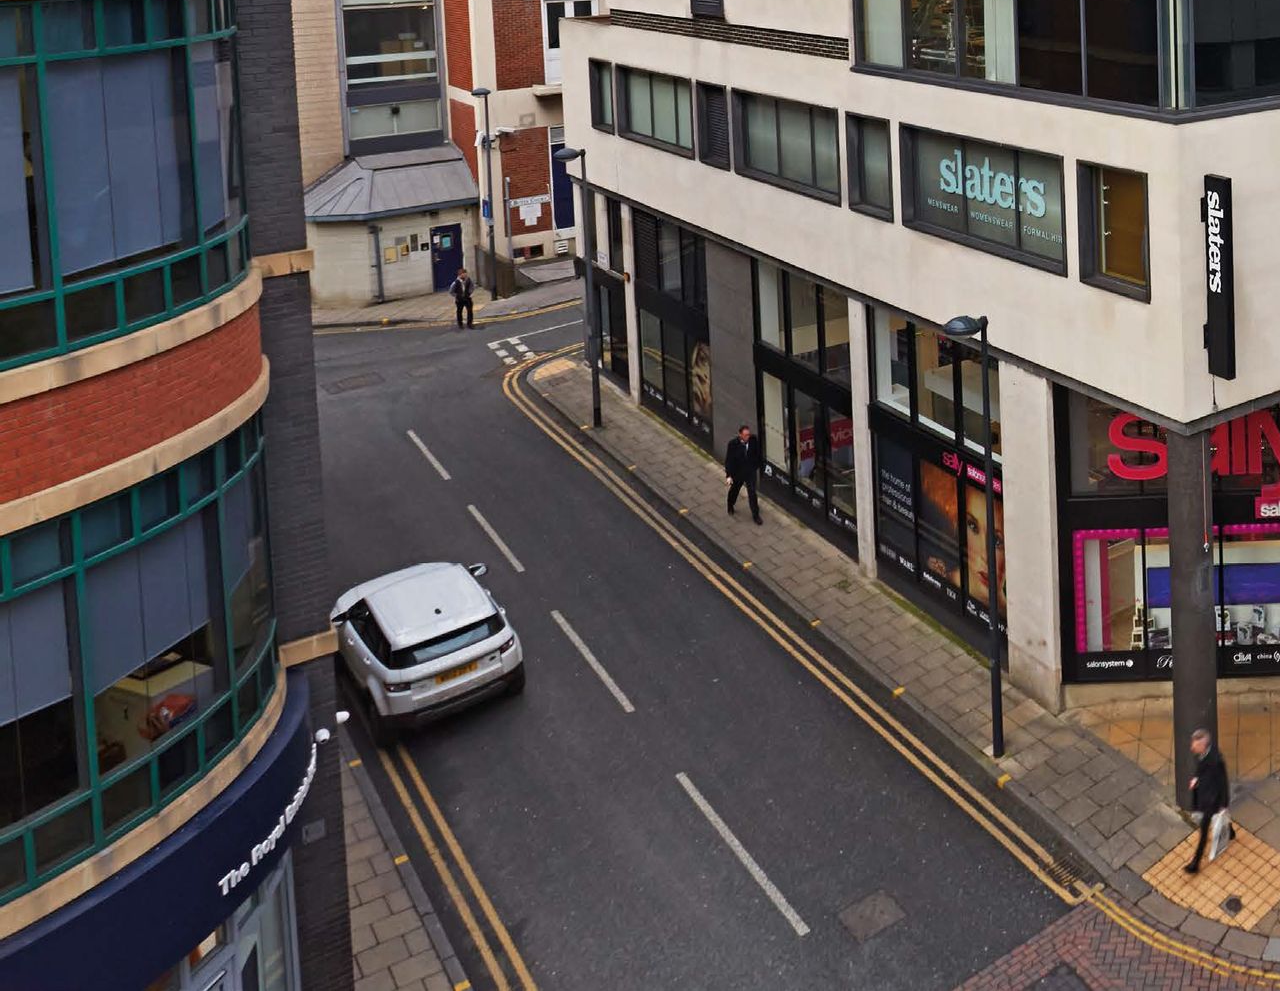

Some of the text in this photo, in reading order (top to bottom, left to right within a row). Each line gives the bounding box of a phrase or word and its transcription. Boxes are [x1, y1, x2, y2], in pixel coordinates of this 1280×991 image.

[940, 149, 1046, 218] slaters
[928, 197, 959, 213] MENSWEAR
[970, 210, 1014, 229] WOMENSWEAR
[1023, 225, 1049, 240] FORMAL
[1207, 191, 1224, 293] slaters
[1086, 659, 1125, 669] salonsystem
[218, 862, 250, 896] The
